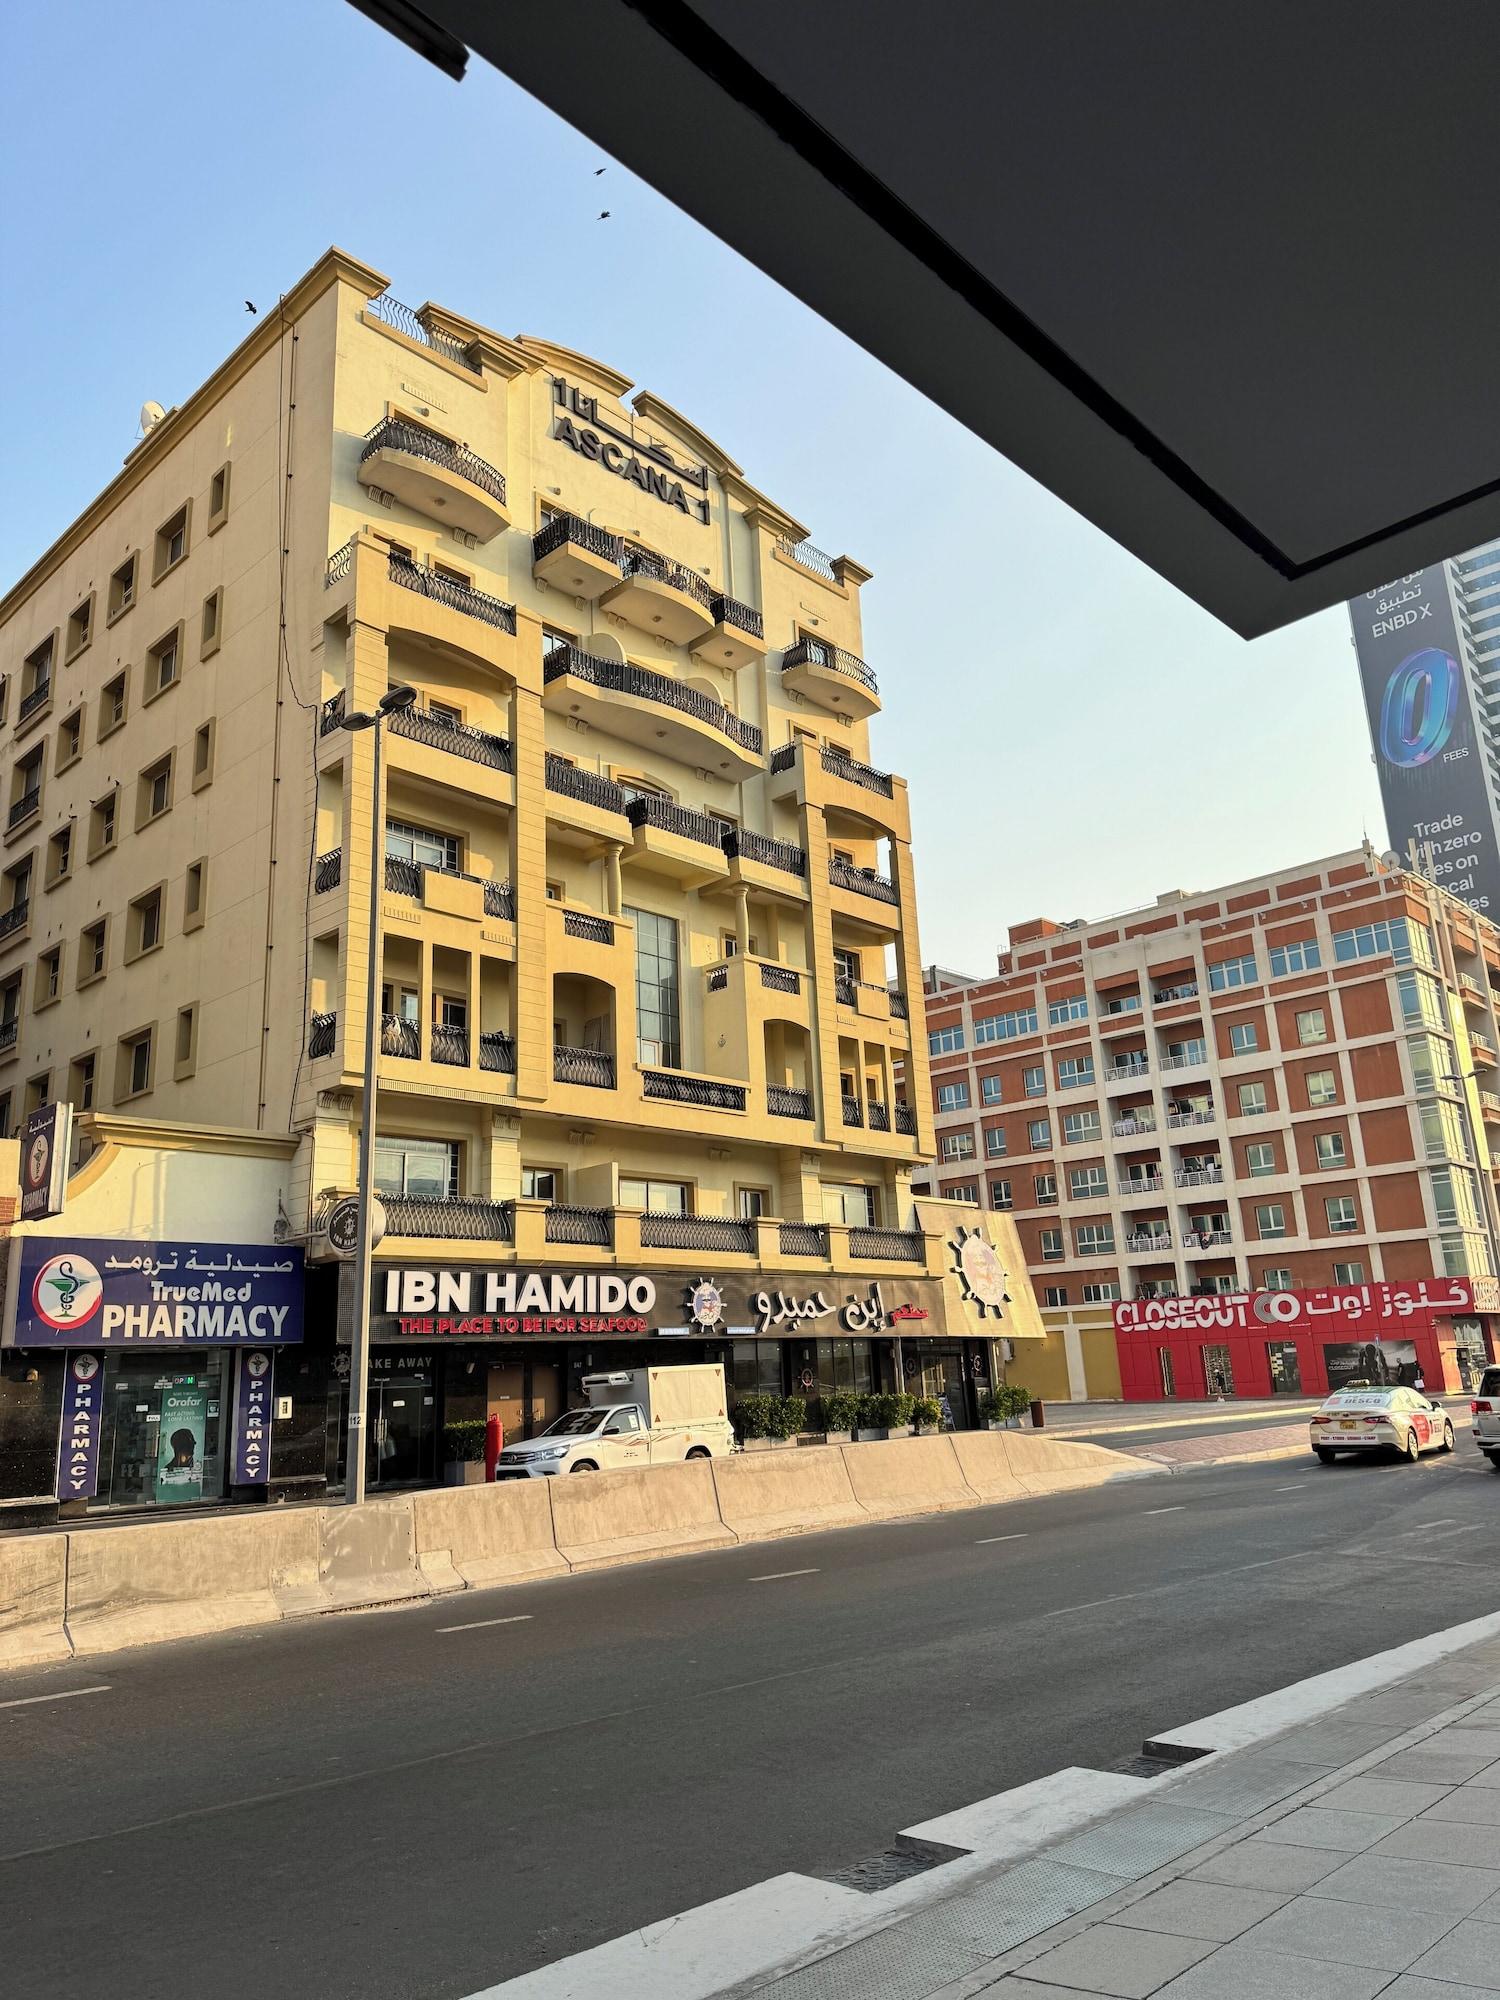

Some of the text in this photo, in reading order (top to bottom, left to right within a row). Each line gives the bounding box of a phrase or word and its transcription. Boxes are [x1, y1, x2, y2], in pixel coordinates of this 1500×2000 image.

[554, 416, 690, 515] ASCANA
[1375, 584, 1422, 615] تطبيق
[1372, 602, 1433, 638] ENBD X
[1443, 747, 1469, 763] FEES
[1413, 814, 1464, 838] Trade
[1443, 831, 1482, 852] zero
[1420, 854, 1479, 879] ees on
[1440, 873, 1475, 894] ocal
[104, 1249, 294, 1278] صيدلية ترومد
[151, 1280, 252, 1302] TrueMed
[386, 1269, 656, 1315] IBN HAMIDO
[102, 1304, 290, 1338] PHARMACY
[400, 1317, 648, 1335] THE PLACE TO BE FOR SEAFOOD
[757, 1291, 837, 1333] حميدو
[1116, 1295, 1249, 1333] CLOSEOUT
[368, 1357, 433, 1368] AKE AWAY
[69, 1383, 92, 1490] PHARMACY
[245, 1380, 264, 1478] PHARMACY
